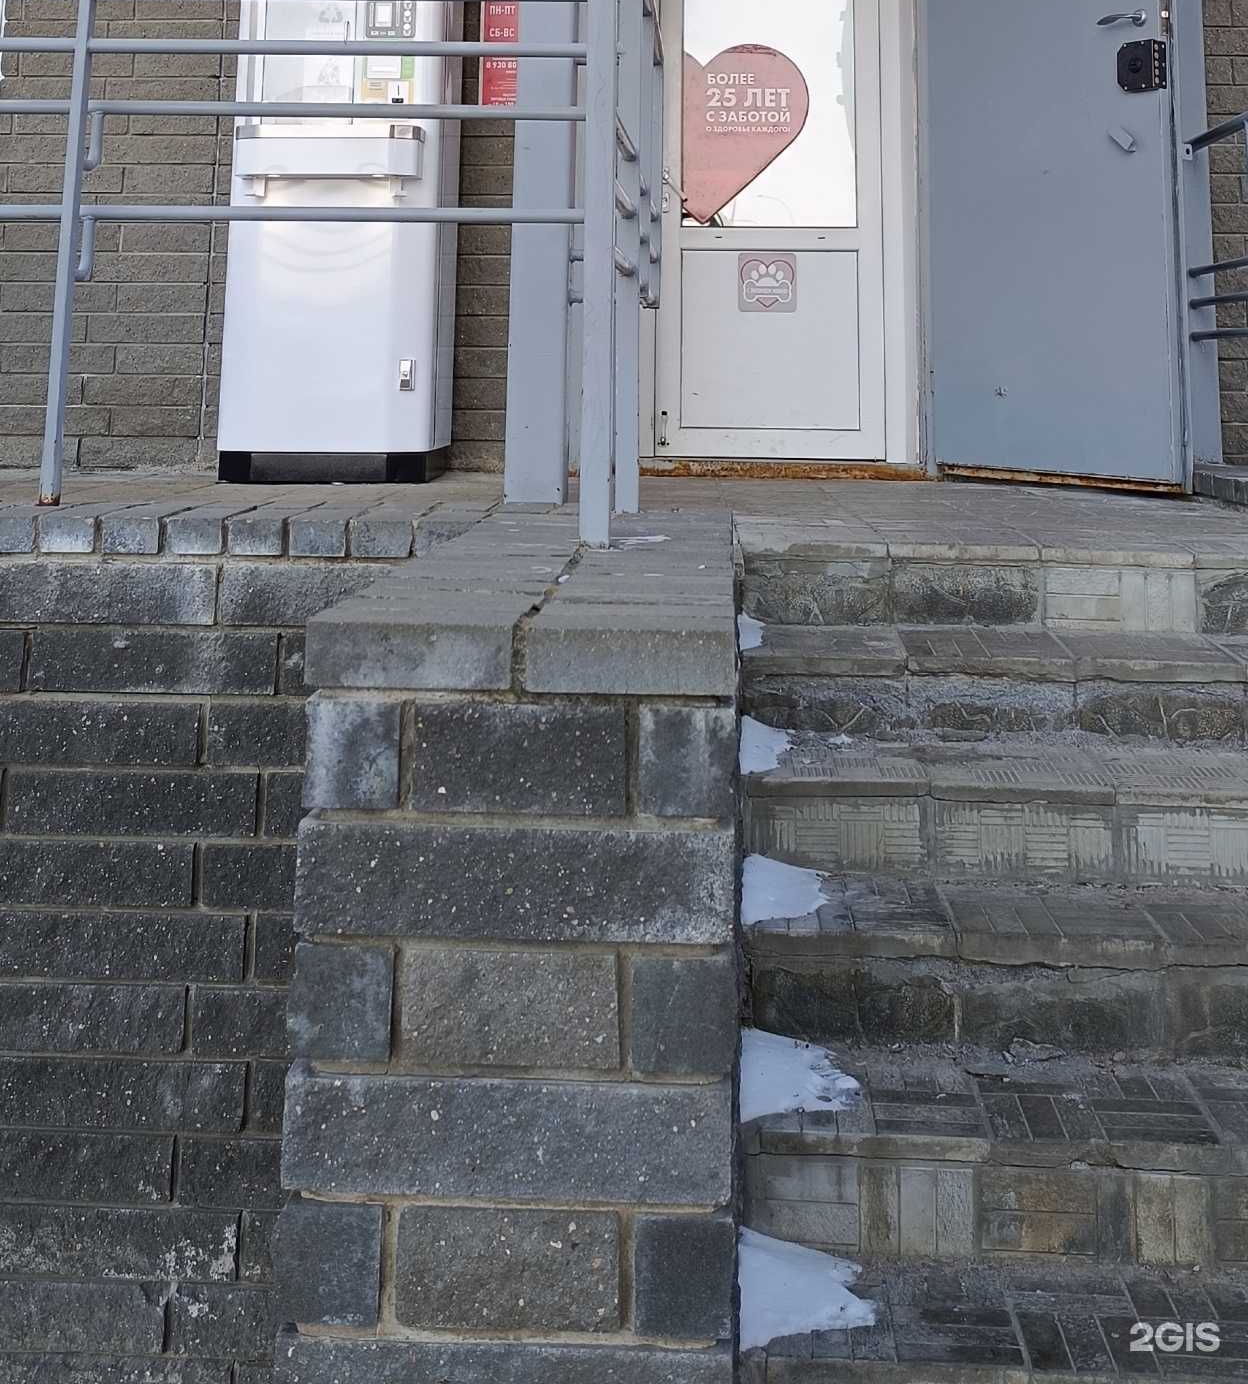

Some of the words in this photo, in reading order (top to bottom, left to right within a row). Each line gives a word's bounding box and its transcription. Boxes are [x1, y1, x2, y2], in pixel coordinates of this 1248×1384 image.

[490, 5, 515, 15] ПН-ПТ
[489, 28, 515, 37] СБ-ВС
[707, 73, 755, 85] БОЛЕЕ
[706, 87, 737, 107] 25
[743, 88, 790, 107] ЛЕТ
[706, 111, 715, 122] С
[719, 108, 790, 122] ЗАБОТОЙ
